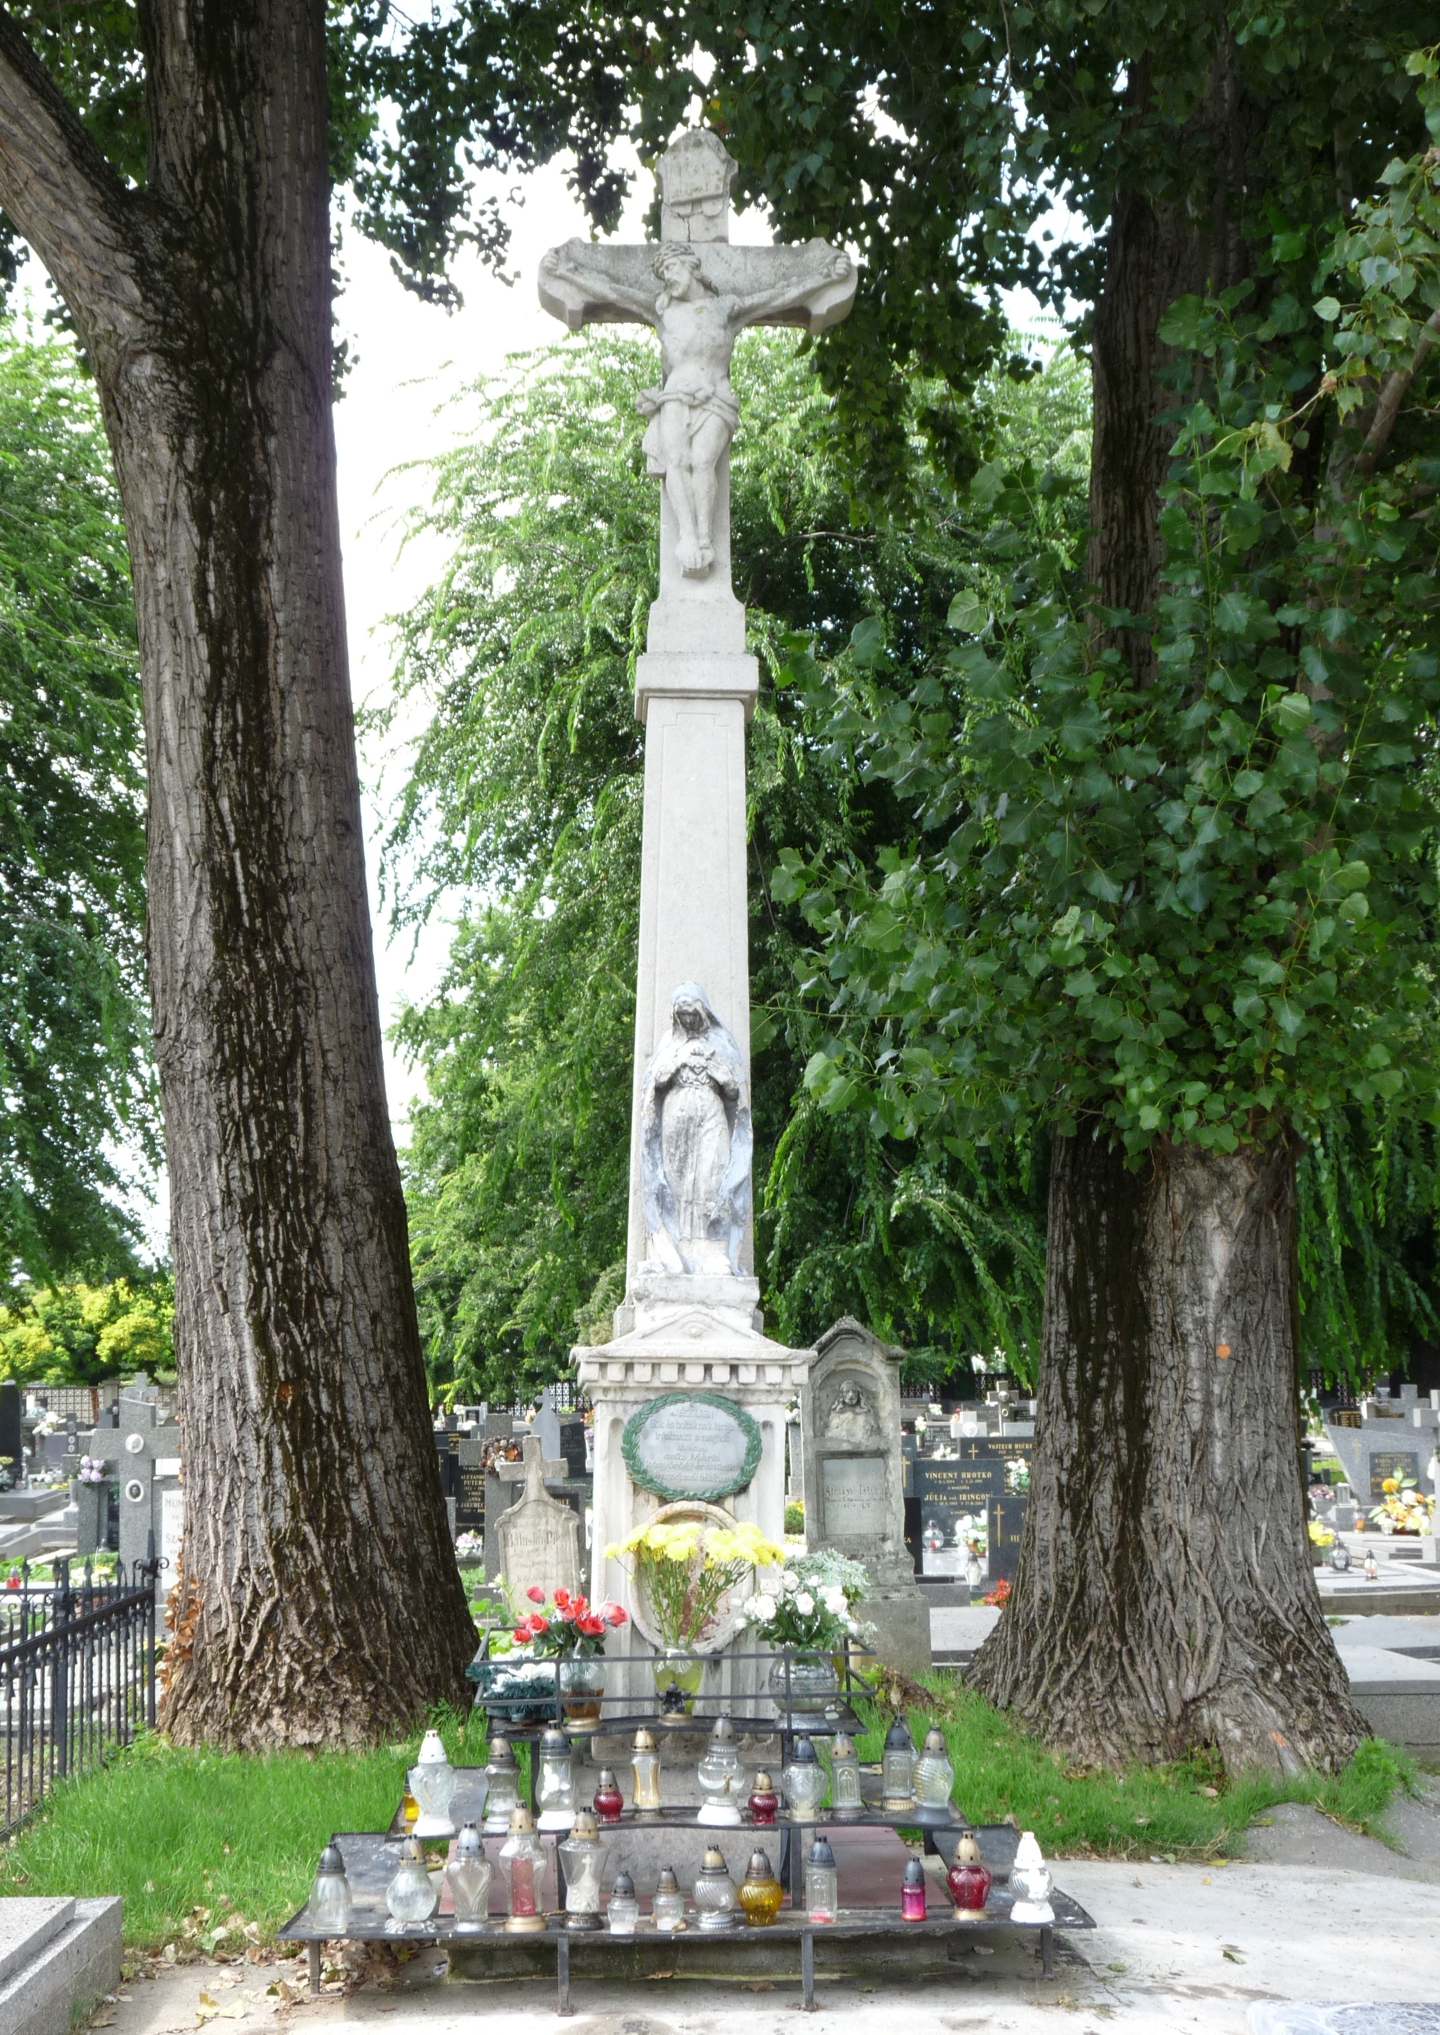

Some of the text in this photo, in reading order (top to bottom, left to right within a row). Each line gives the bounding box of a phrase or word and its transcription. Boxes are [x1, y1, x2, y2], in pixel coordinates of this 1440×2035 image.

[925, 1471, 992, 1480] VINCENT HROTKO
[924, 1491, 948, 1501] JÚLIA
